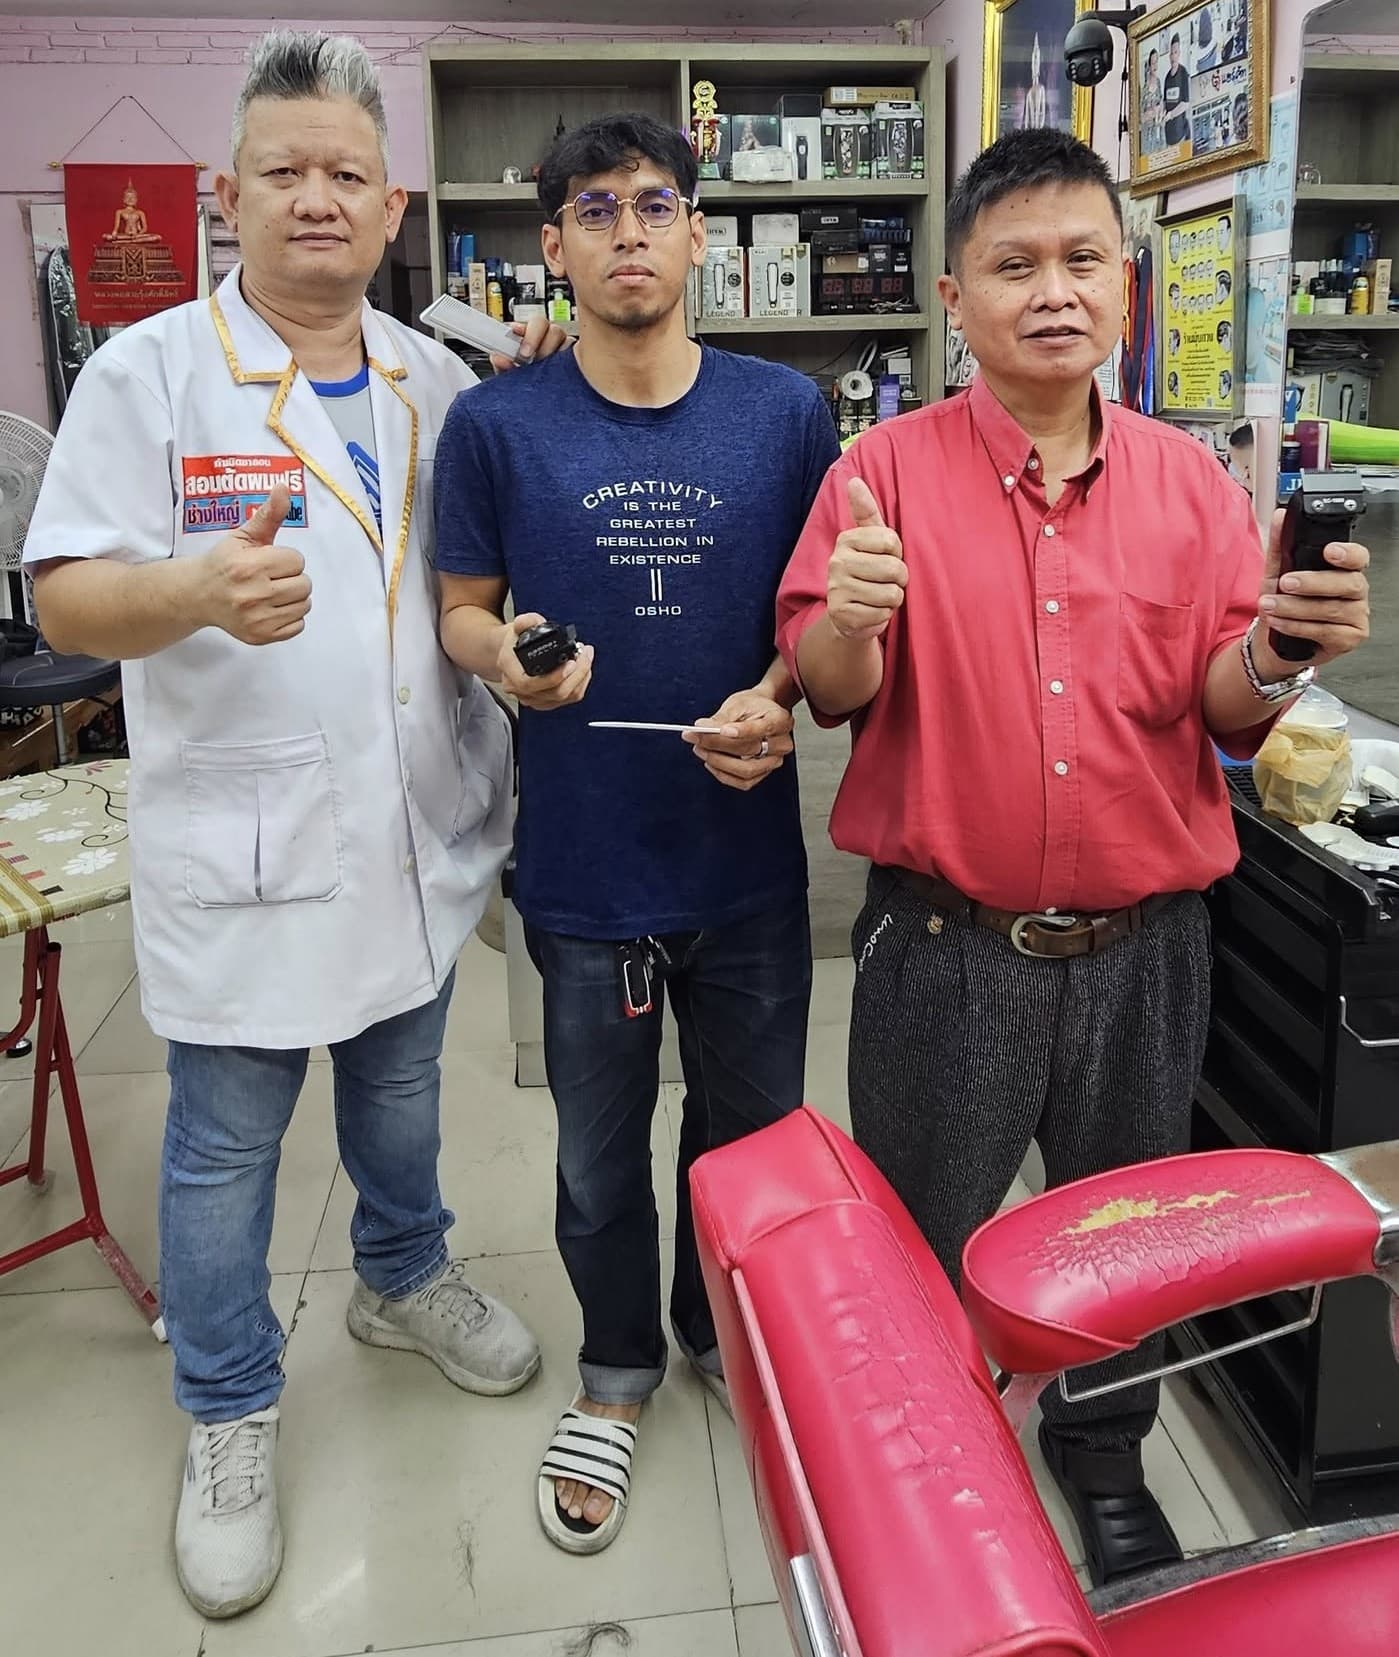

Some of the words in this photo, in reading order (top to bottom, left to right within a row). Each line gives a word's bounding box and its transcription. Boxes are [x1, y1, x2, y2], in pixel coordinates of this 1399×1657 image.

[705, 310, 736, 318] LEGEND
[759, 309, 789, 317] LEGEND
[582, 480, 723, 509] CREATIVITY
[623, 501, 640, 511] IS
[648, 501, 681, 511] THE
[187, 499, 241, 525] ช่างใหญ่
[610, 518, 697, 529] GREATEST
[596, 536, 688, 547] REBELLION
[696, 535, 714, 546] IN
[609, 554, 702, 565] EXISTENCE
[634, 606, 682, 616] OSHO
